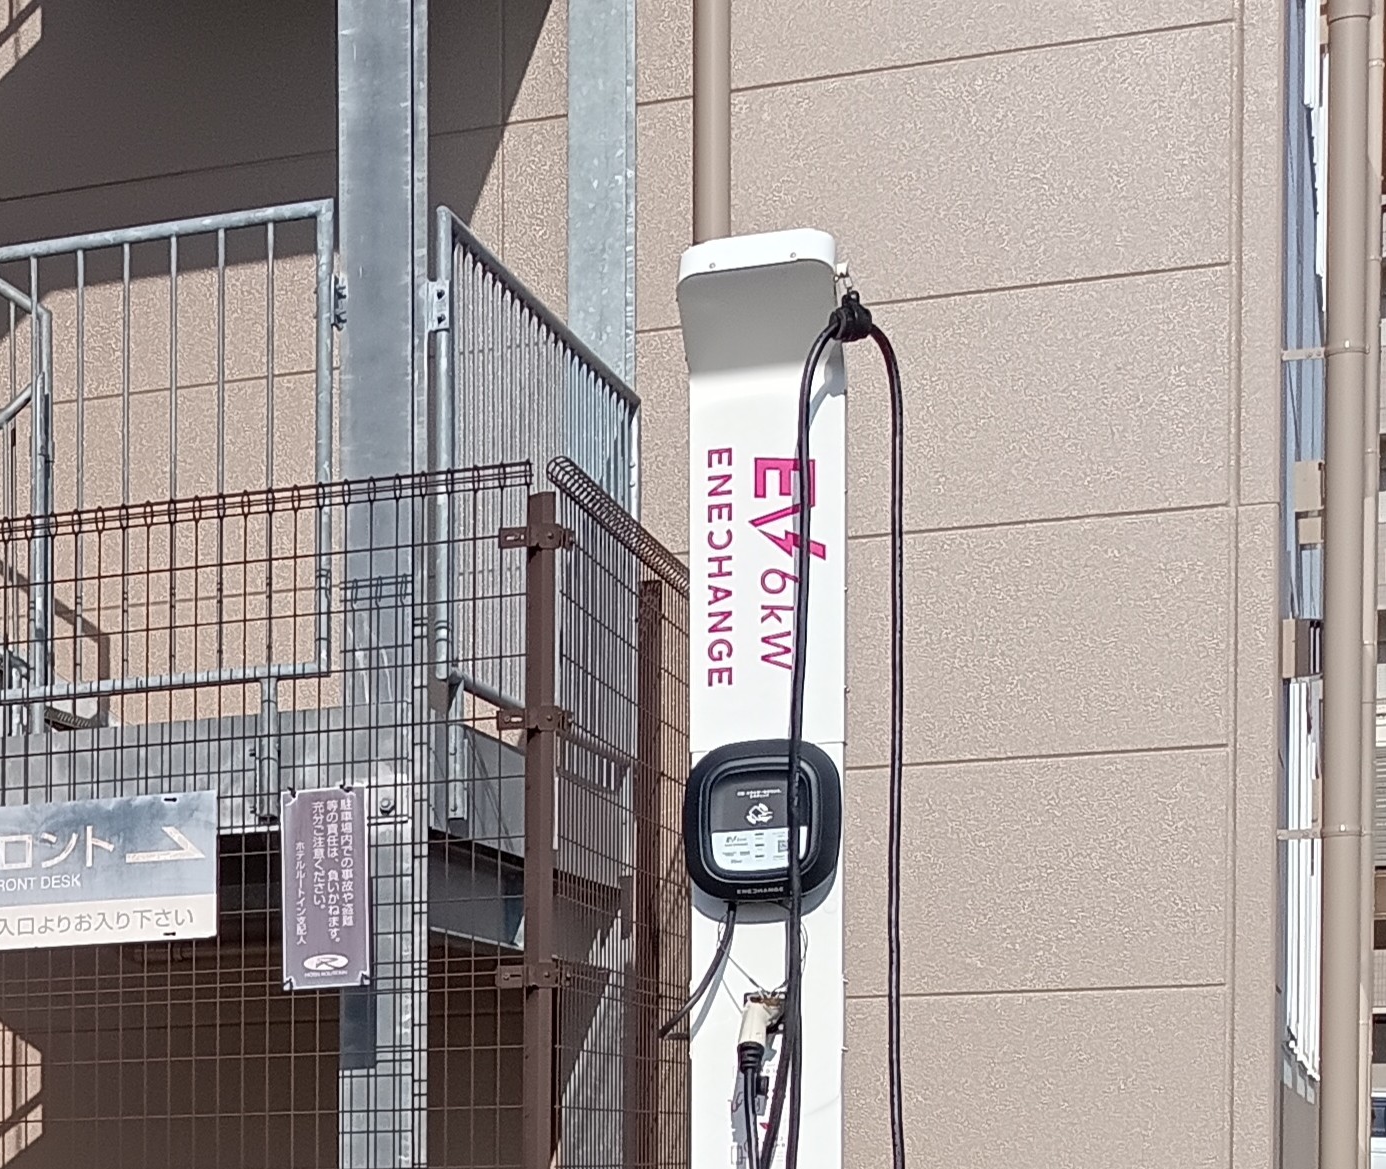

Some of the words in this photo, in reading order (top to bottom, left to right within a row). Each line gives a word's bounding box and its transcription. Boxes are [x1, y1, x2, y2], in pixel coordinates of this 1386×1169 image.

[748, 457, 826, 560] EV
[760, 568, 799, 671] 6kW
[40, 873, 82, 890] DESK
[295, 842, 307, 945] ホテルルートイン支配人
[312, 801, 326, 909] 充分ご注意ください。
[340, 798, 354, 926] 駐車場内での事故や盗難
